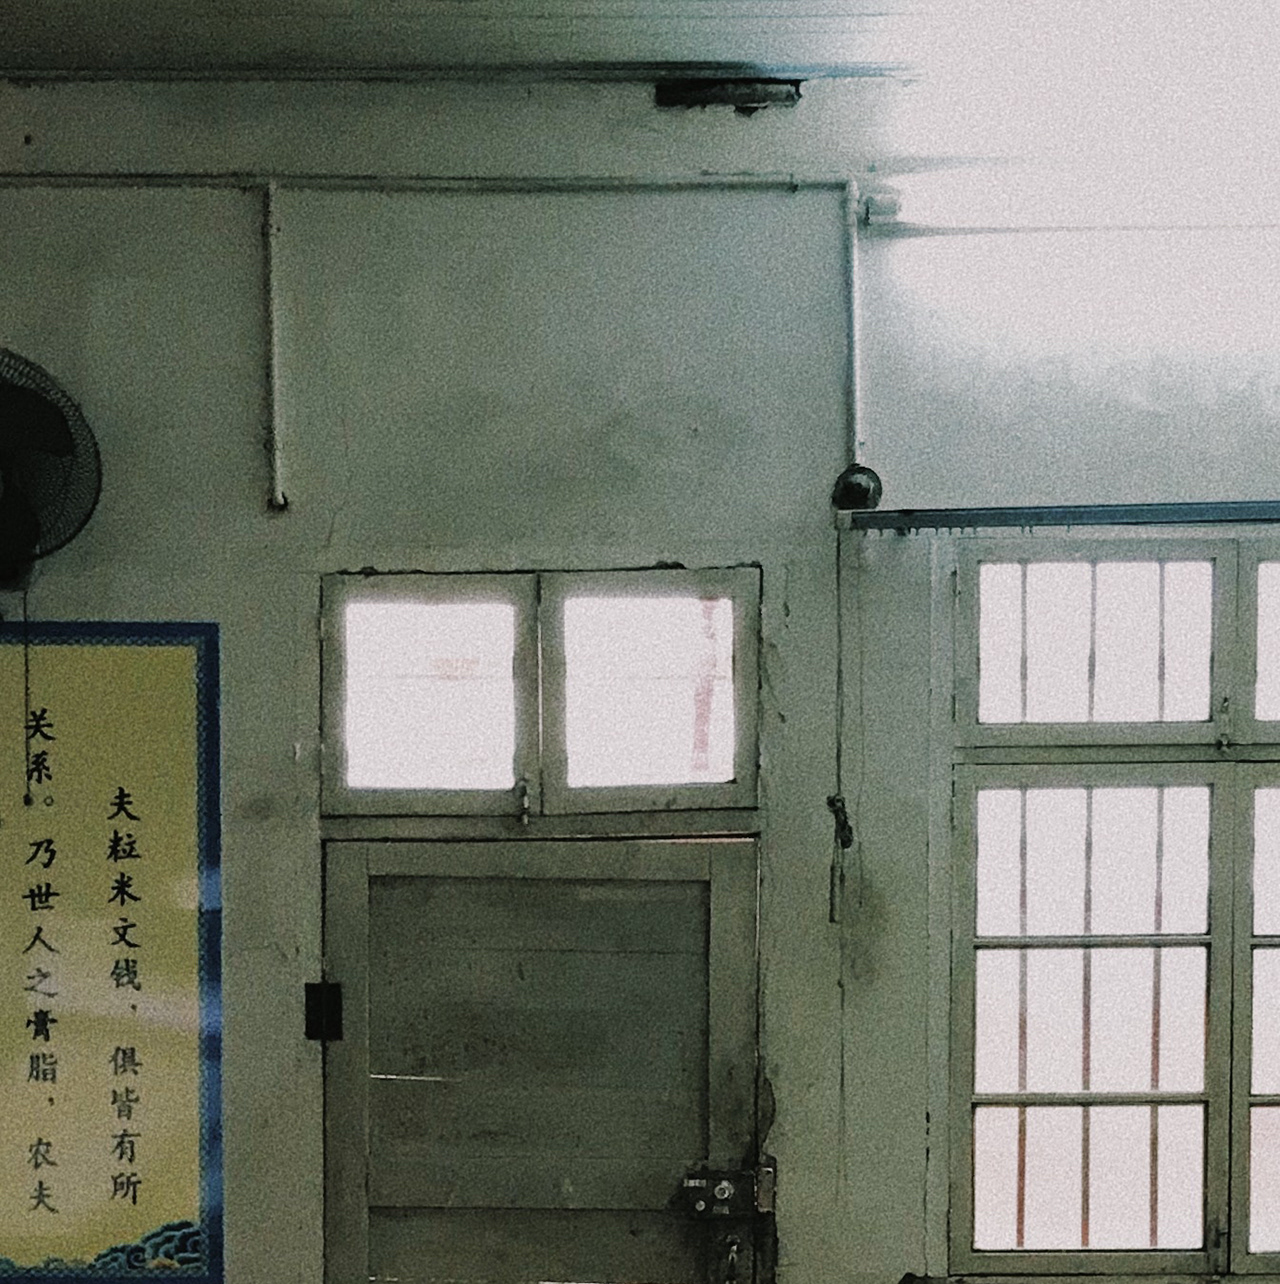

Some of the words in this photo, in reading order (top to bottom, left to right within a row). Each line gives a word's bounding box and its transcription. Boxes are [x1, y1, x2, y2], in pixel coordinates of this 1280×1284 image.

[22, 708, 61, 1215] 关系。乃世人之膏脂，农夫
[107, 786, 143, 1206] 夫粒米文钱，俱皆有所
